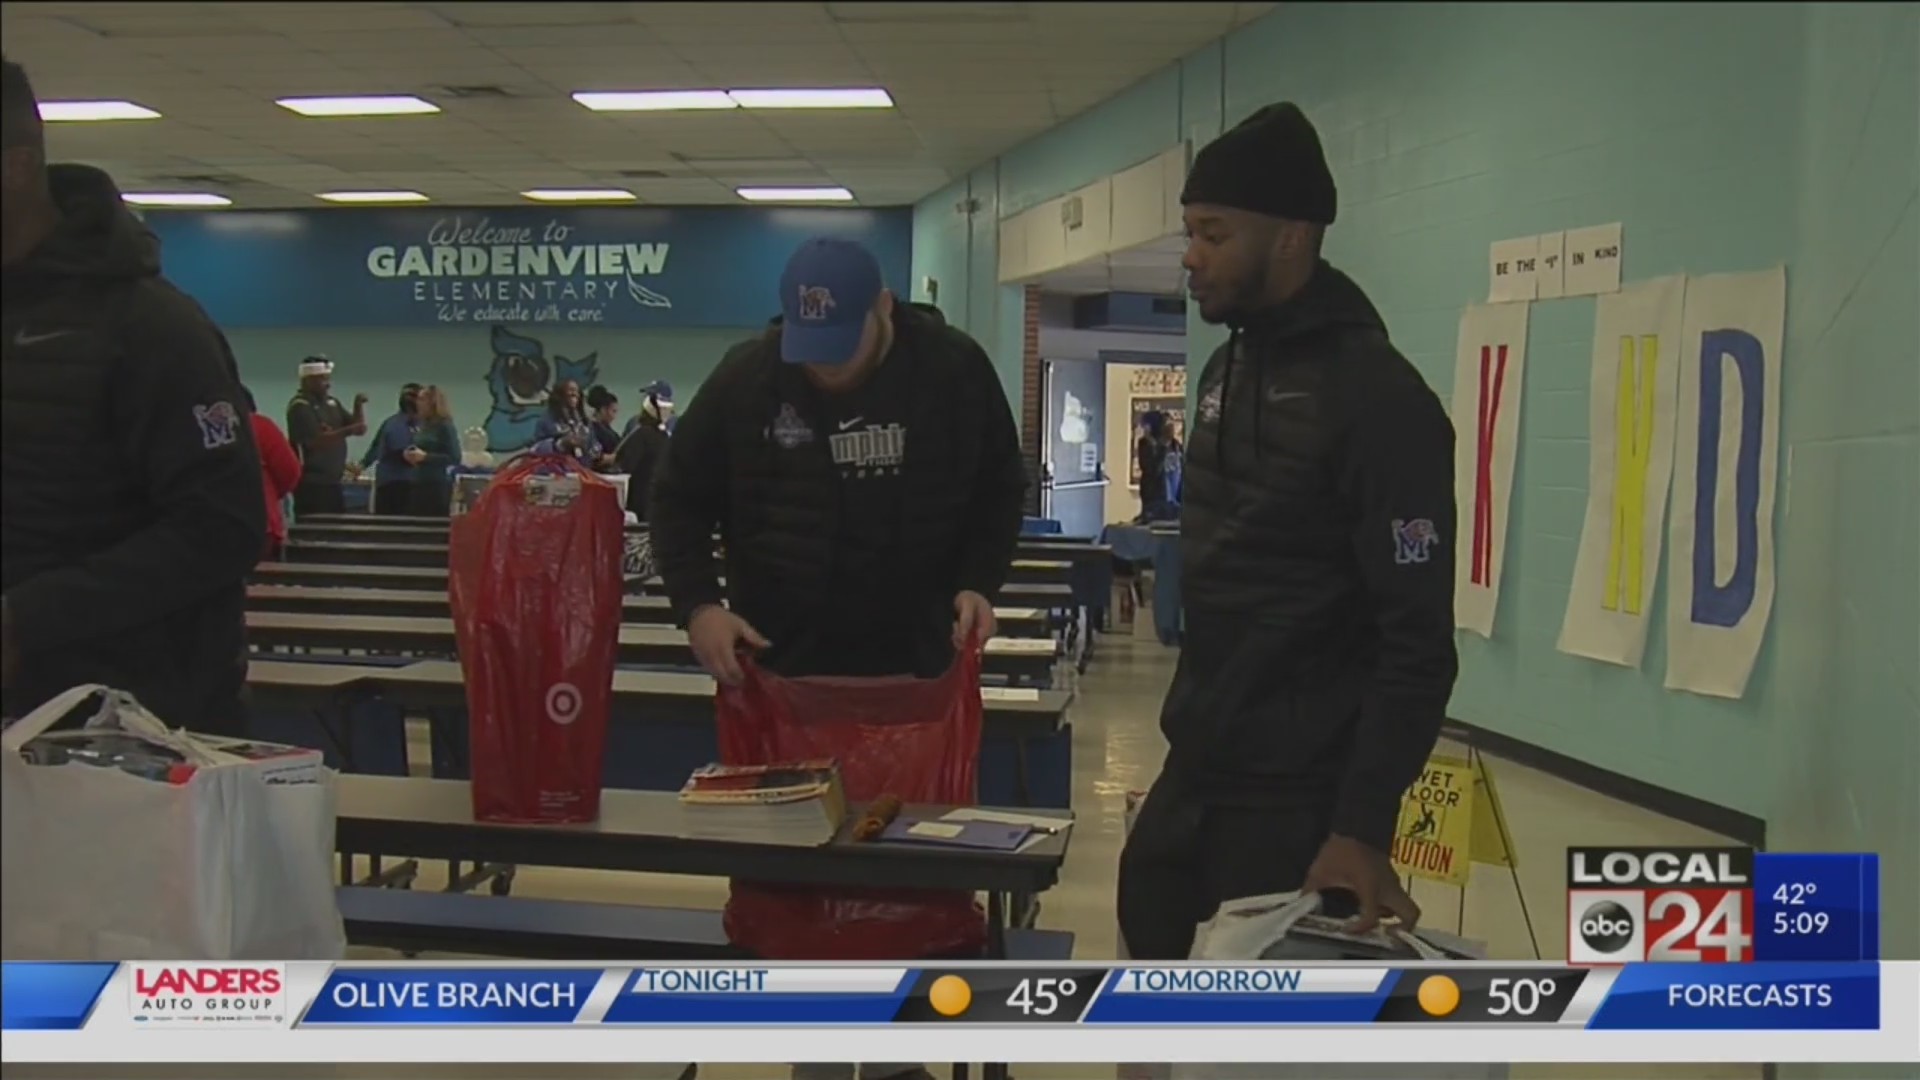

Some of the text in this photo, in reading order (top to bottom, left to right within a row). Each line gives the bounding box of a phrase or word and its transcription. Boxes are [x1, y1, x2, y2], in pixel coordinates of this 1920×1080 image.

[427, 217, 575, 246] Welcome to
[367, 243, 669, 277] GARDENVIEW
[1496, 262, 1509, 276] BE
[1517, 258, 1536, 273] THE
[1572, 252, 1585, 266] IN
[414, 281, 619, 301] ELEMENTARY
[473, 303, 529, 322] educate
[1470, 345, 1509, 587] K
[1691, 328, 1764, 627] D
[1409, 785, 1460, 807] LOOR
[1393, 837, 1454, 874] AUTION
